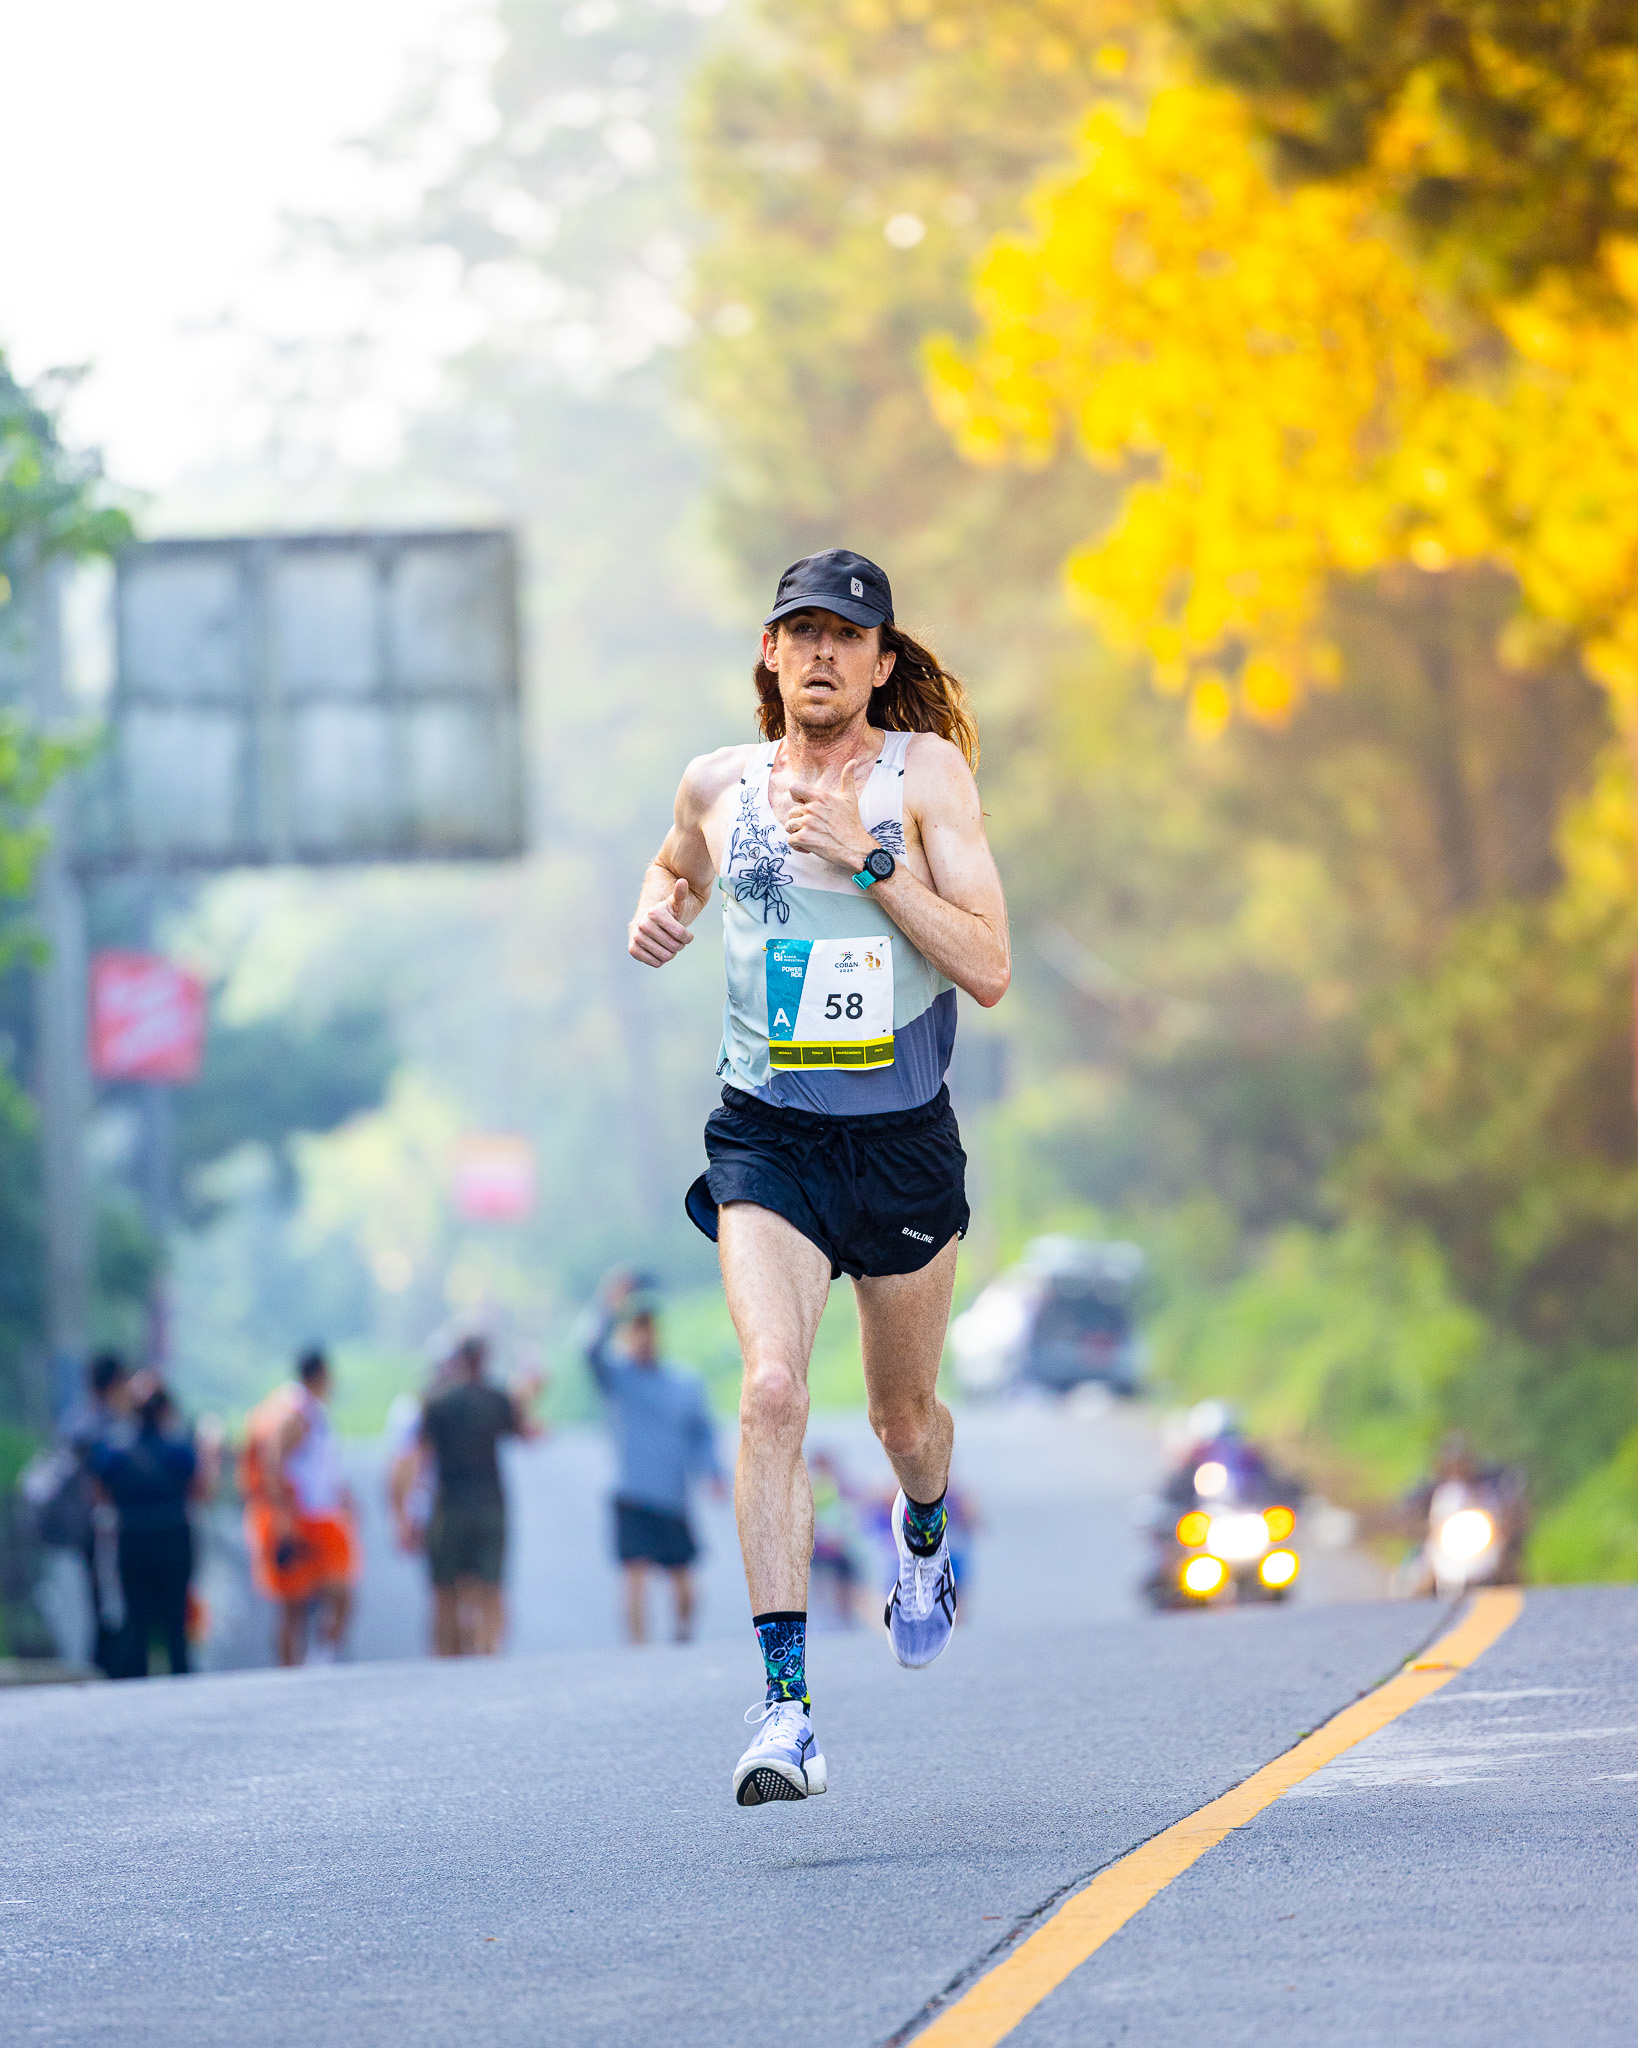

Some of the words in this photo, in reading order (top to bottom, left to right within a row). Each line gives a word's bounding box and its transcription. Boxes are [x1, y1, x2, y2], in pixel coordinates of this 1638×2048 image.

[824, 992, 863, 1020] 58
[772, 1007, 791, 1027] A
[901, 1226, 935, 1244] BAKLINE
